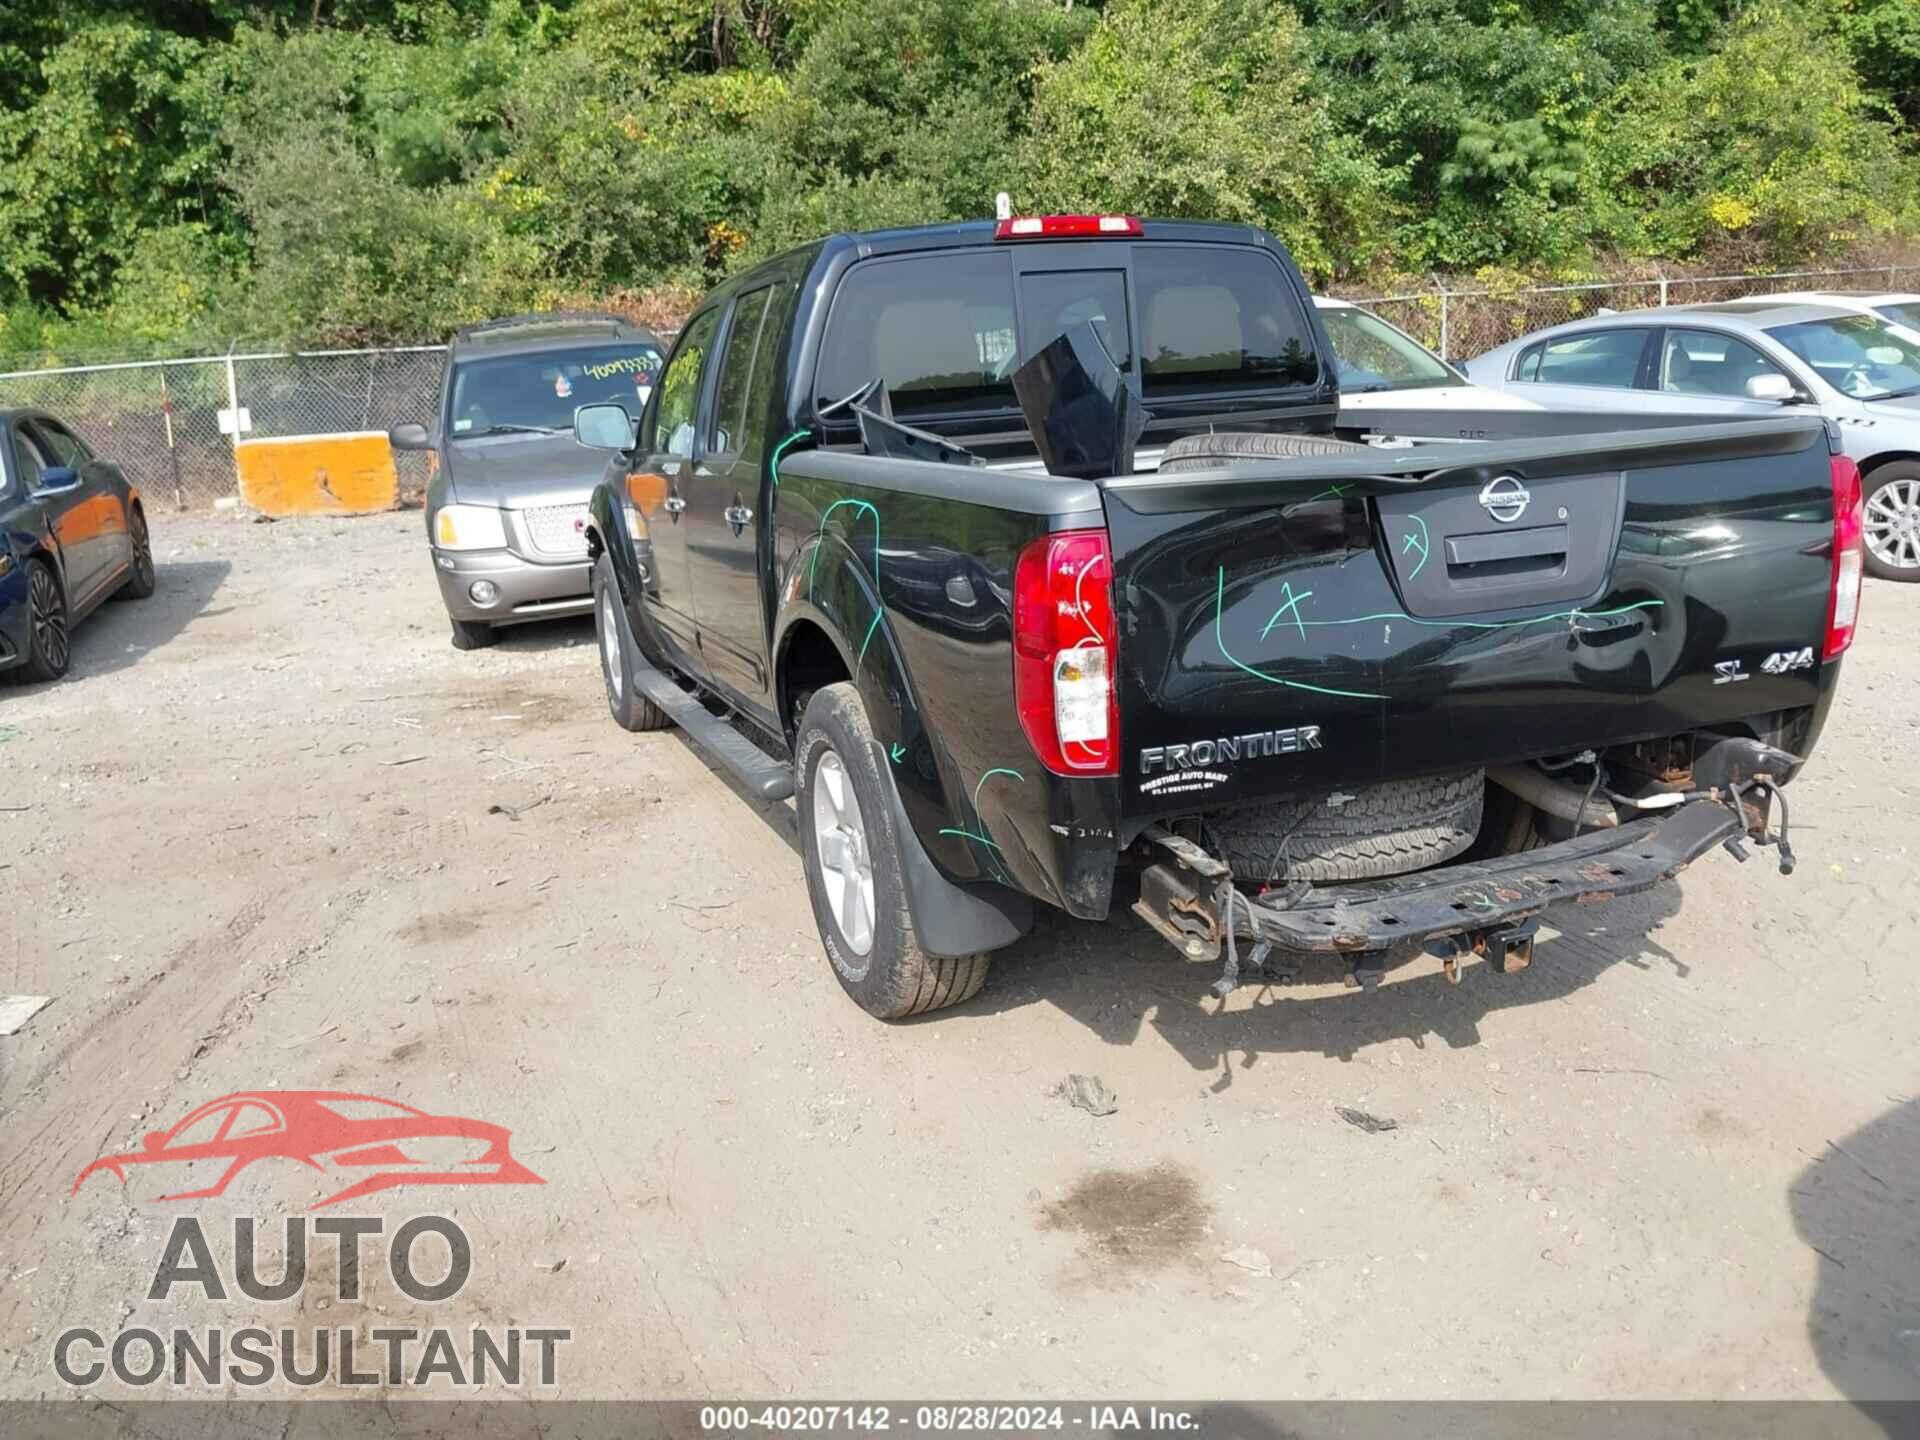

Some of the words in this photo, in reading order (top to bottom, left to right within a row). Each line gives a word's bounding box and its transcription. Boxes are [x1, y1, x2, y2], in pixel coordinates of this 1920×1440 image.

[1486, 492, 1528, 505] NISSAN
[1712, 659, 1750, 685] SL
[1140, 725, 1322, 774] FRONTIER
[1139, 773, 1181, 793] PRESTIGE
[1181, 771, 1204, 781] AUTO
[1204, 771, 1229, 783] MART
